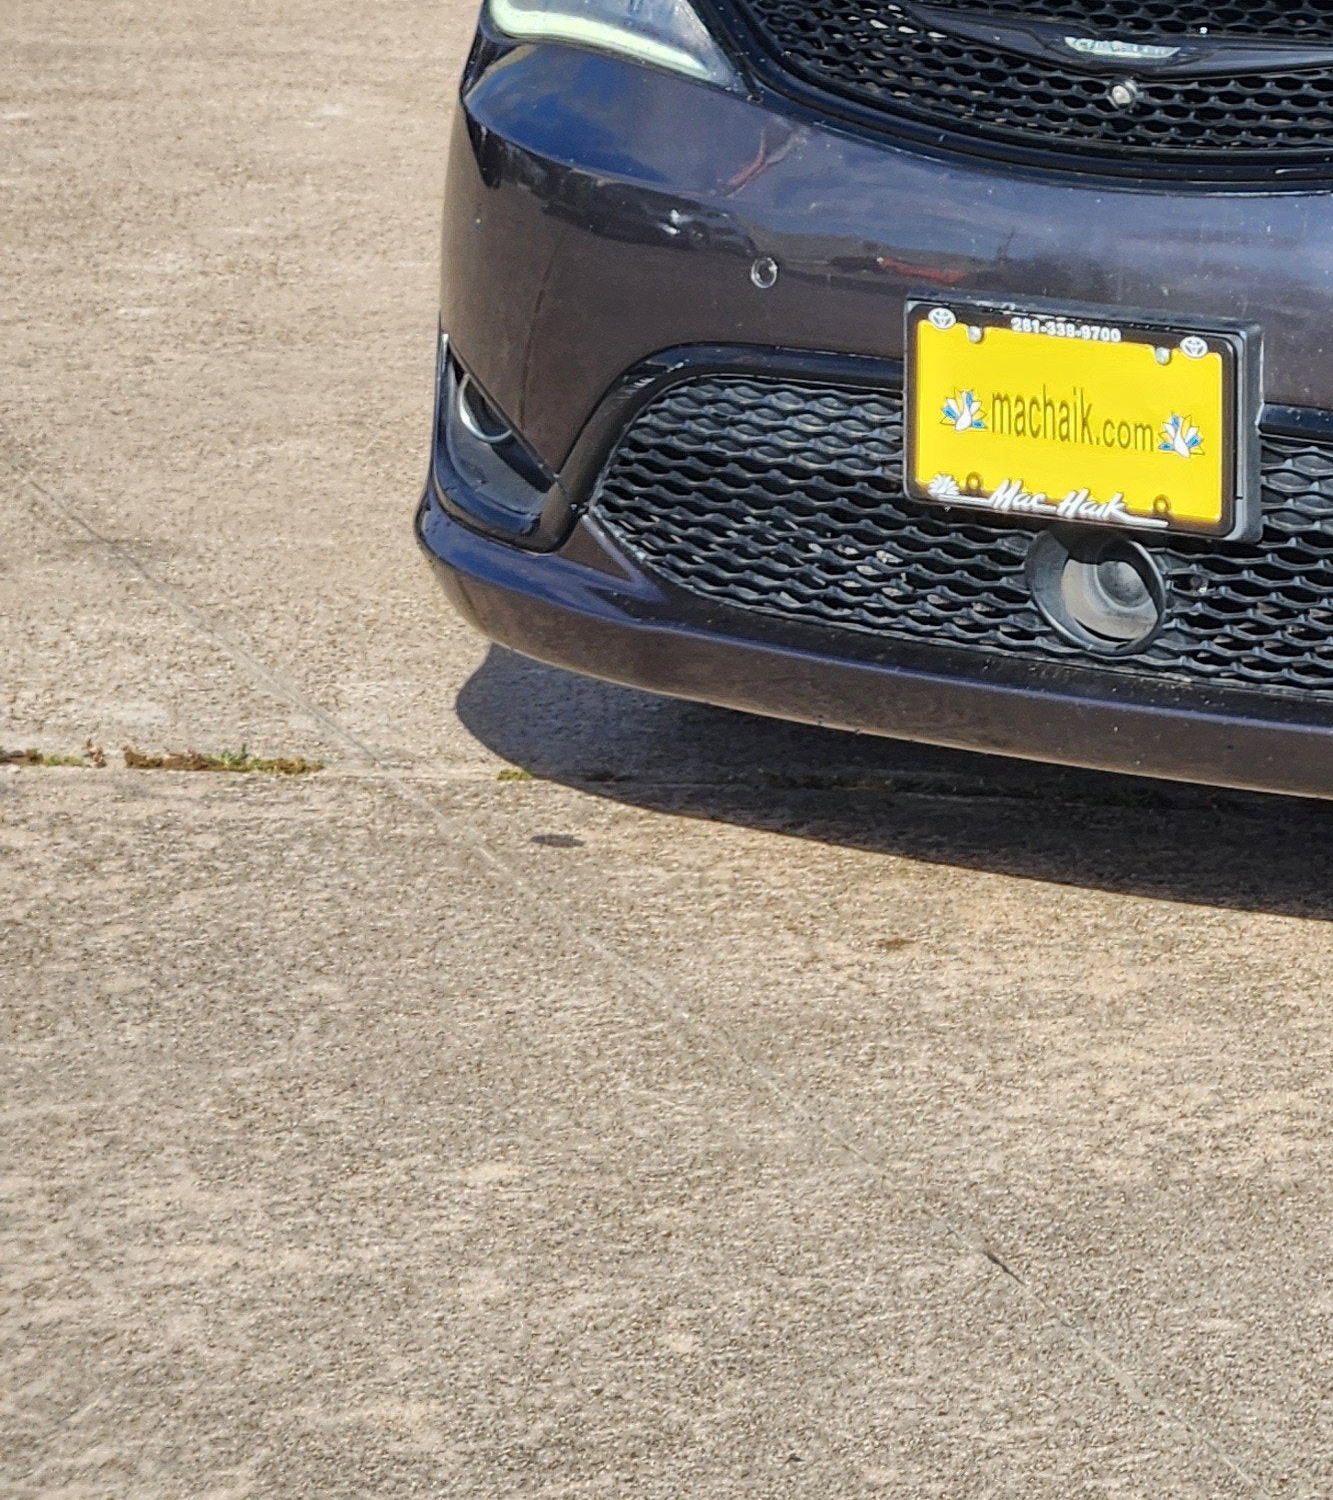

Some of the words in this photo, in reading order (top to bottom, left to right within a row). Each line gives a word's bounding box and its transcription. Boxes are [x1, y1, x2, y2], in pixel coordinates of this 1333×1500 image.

[1010, 316, 1122, 344] 281-338-9700
[990, 384, 1156, 453] machaik.com
[989, 478, 1047, 511] Mac
[1056, 488, 1132, 525] Haik
